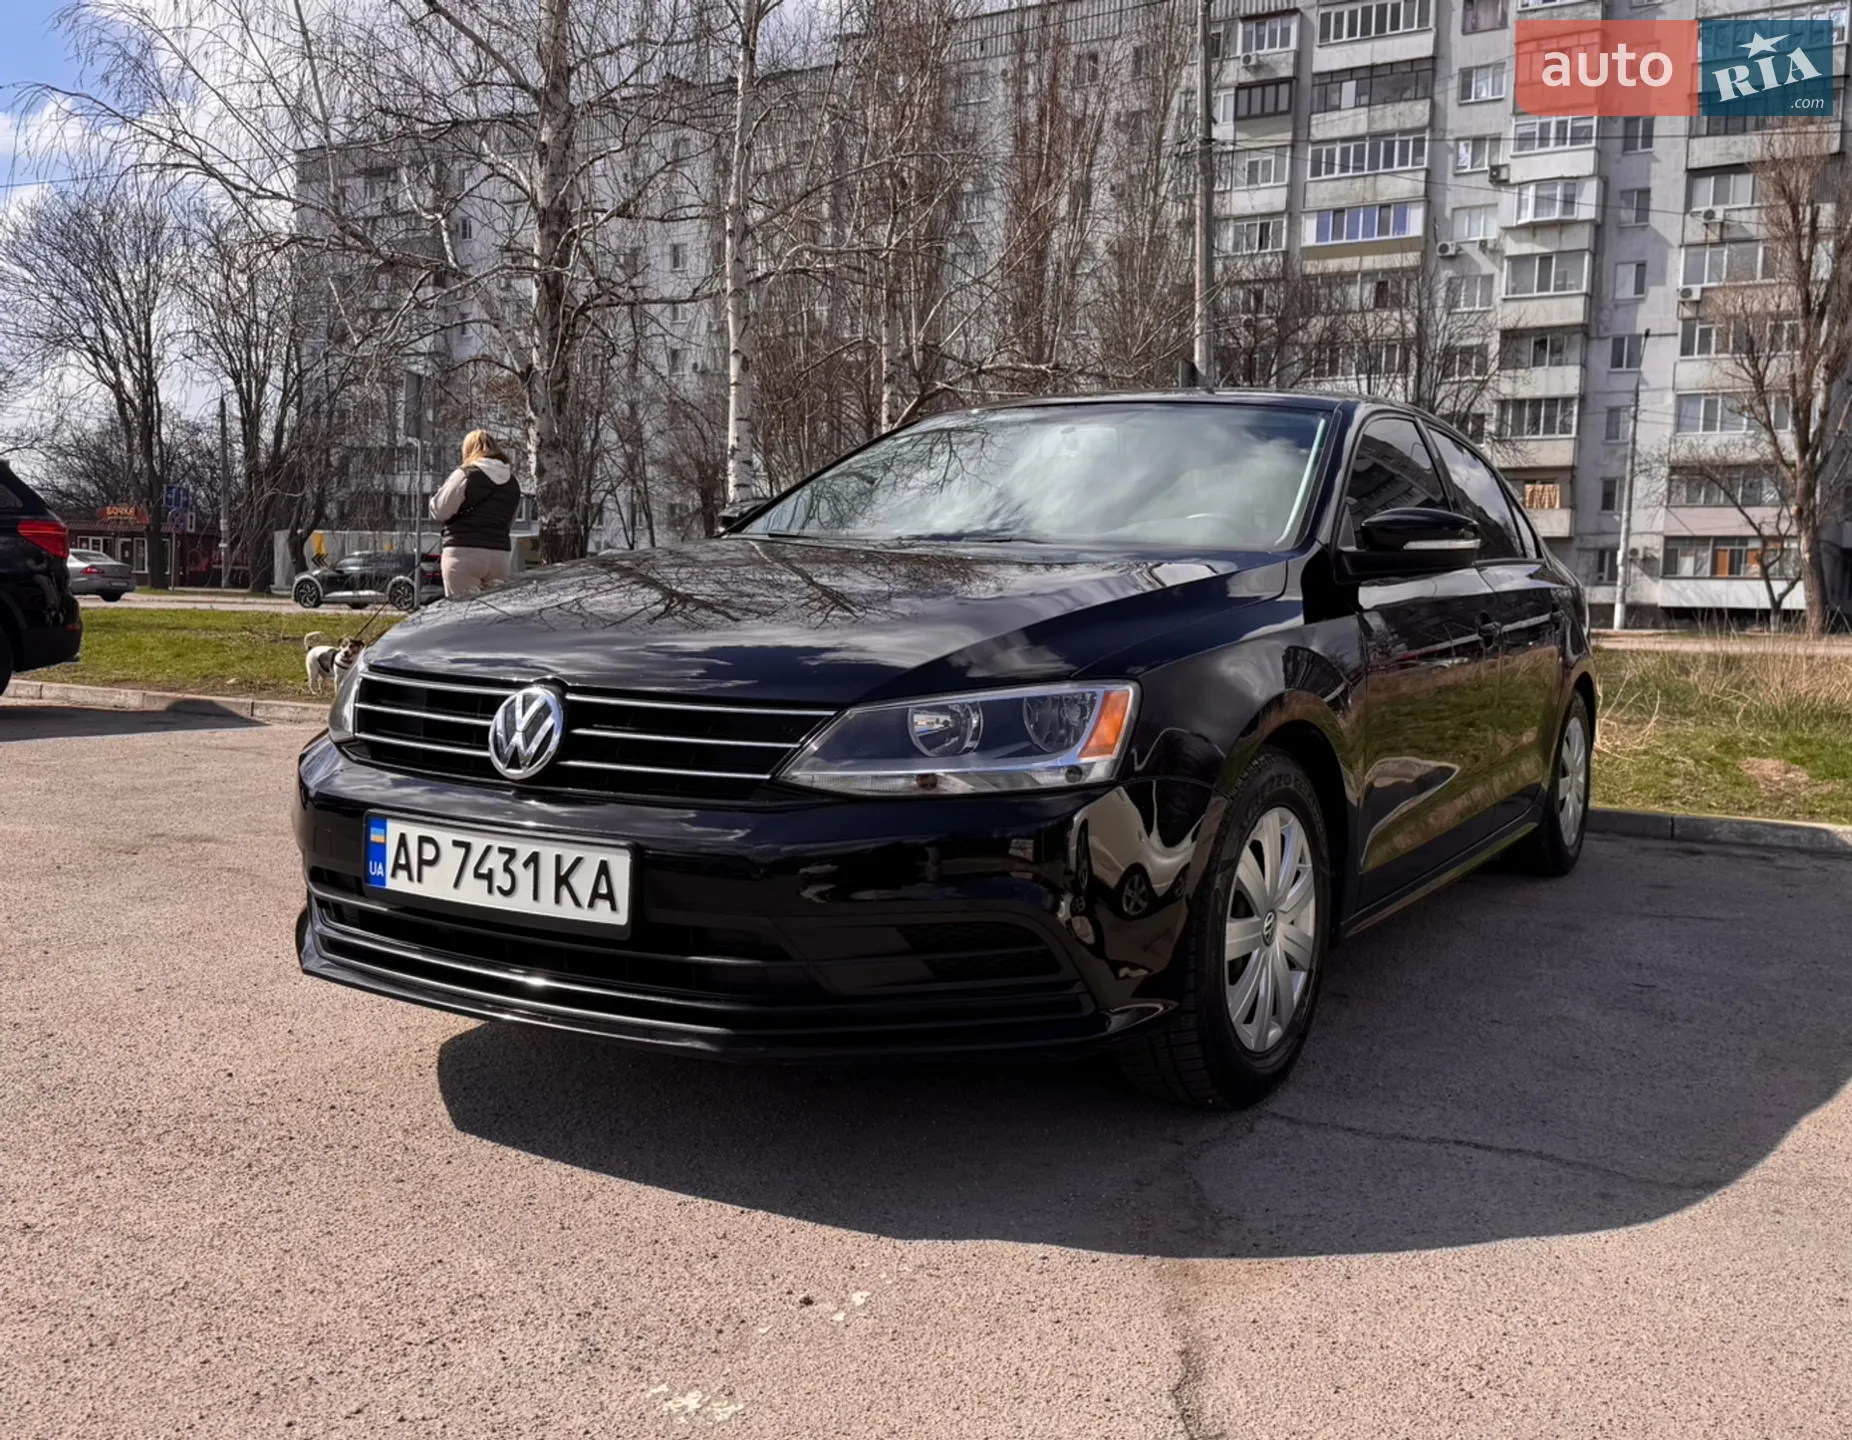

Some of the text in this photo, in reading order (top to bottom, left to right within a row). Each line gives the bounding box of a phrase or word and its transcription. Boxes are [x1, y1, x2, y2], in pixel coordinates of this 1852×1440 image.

[490, 687, 563, 779] VW
[369, 860, 385, 877] UA
[390, 831, 618, 912] AP 7431 KA
